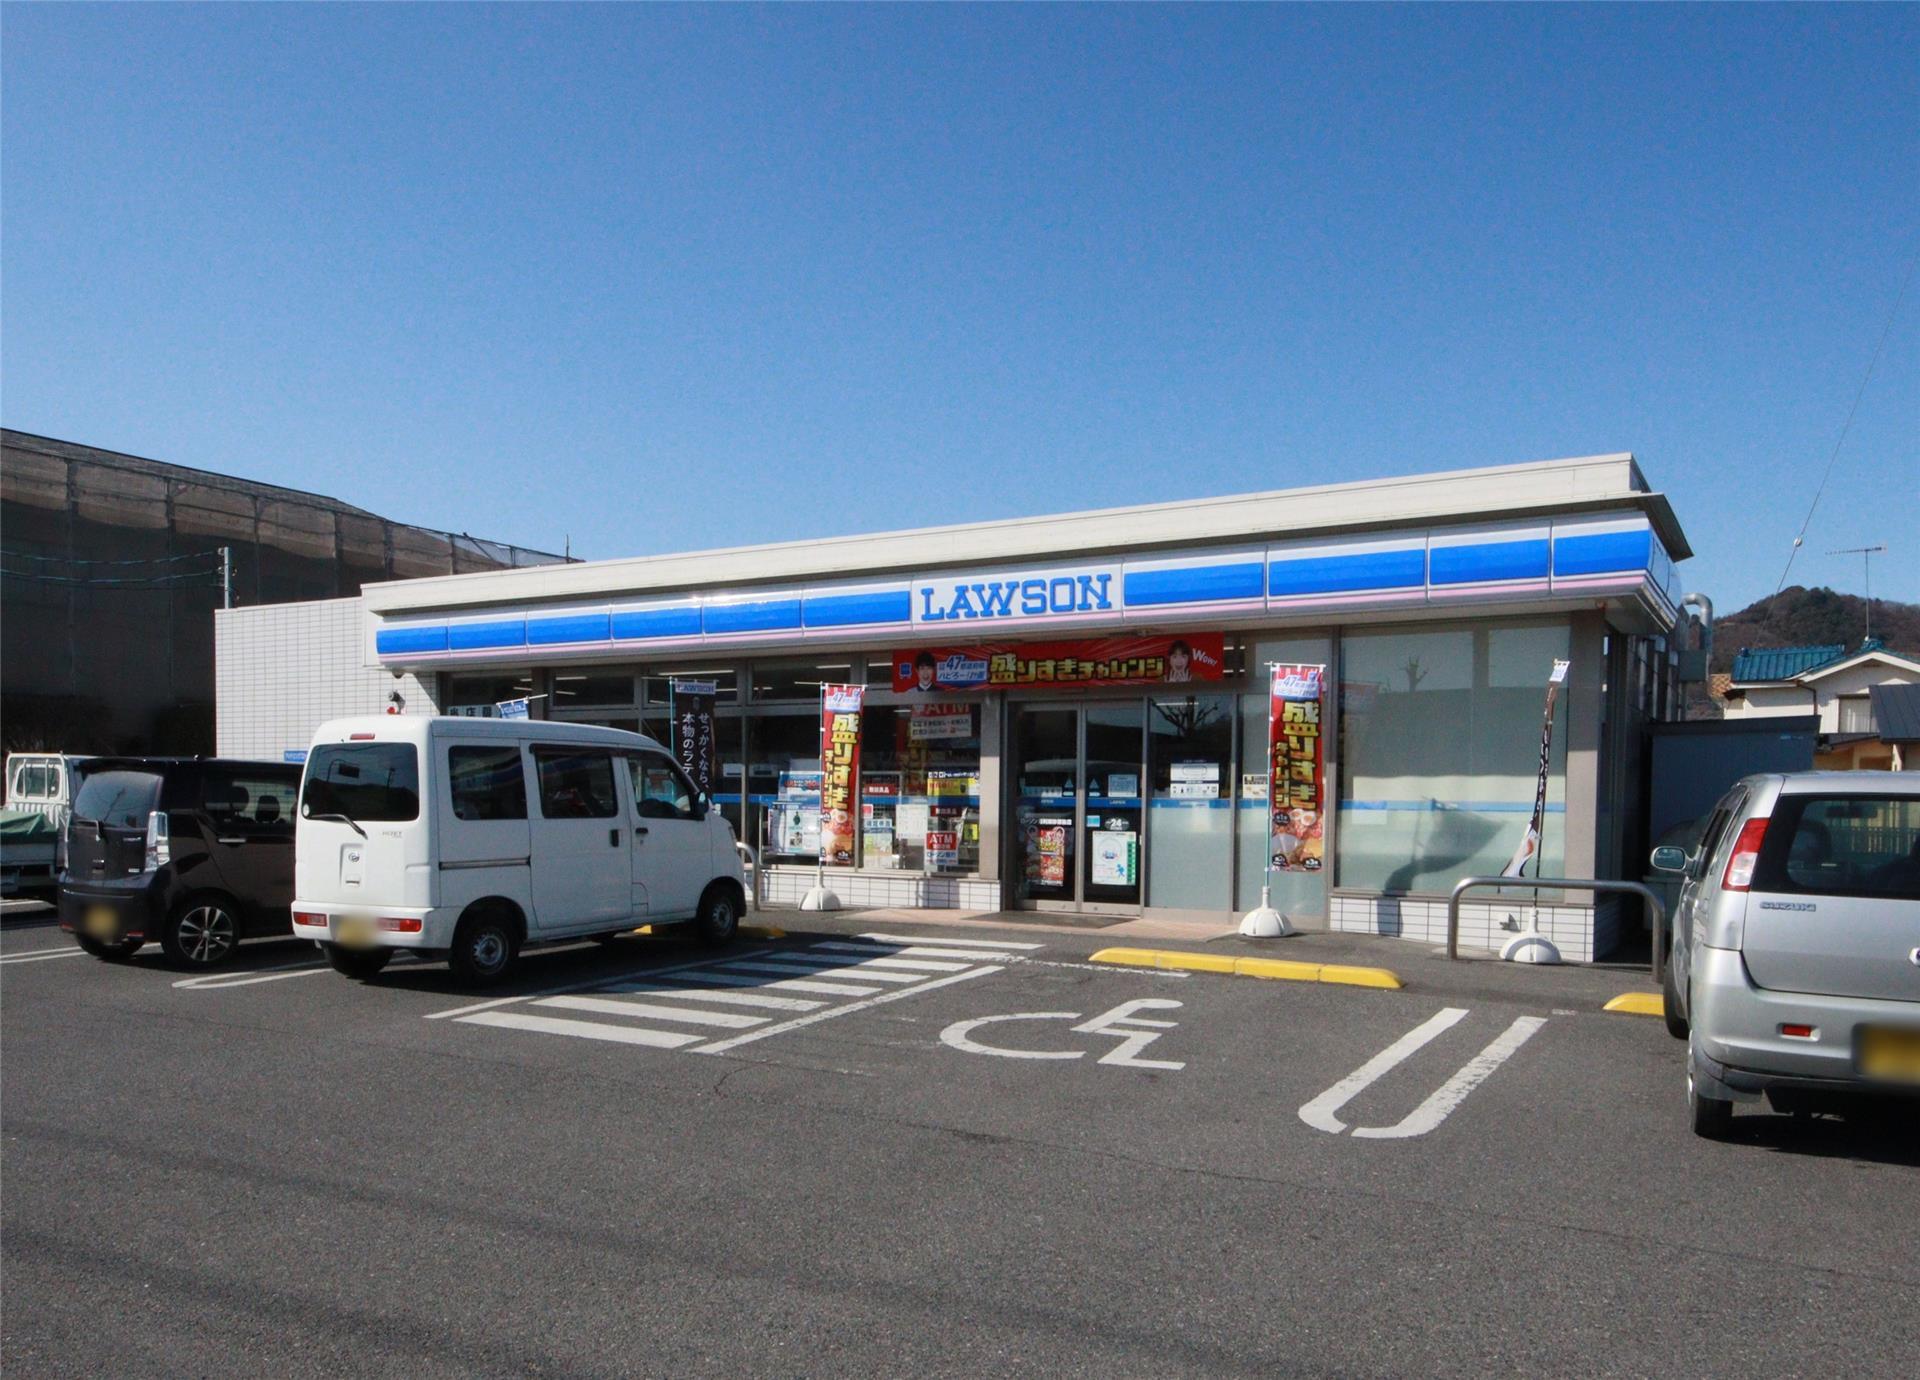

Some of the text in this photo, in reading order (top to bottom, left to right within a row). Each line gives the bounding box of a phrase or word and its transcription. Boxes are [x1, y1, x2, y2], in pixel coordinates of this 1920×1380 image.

[921, 574, 1112, 621] LAWSON
[990, 654, 1164, 684] 盛りすぎチャレンジ
[831, 713, 859, 809] 盛りすぎ
[1282, 701, 1320, 808] 盛りすぎ
[930, 834, 952, 843] ATM
[1760, 902, 1816, 912] SUZUKI
